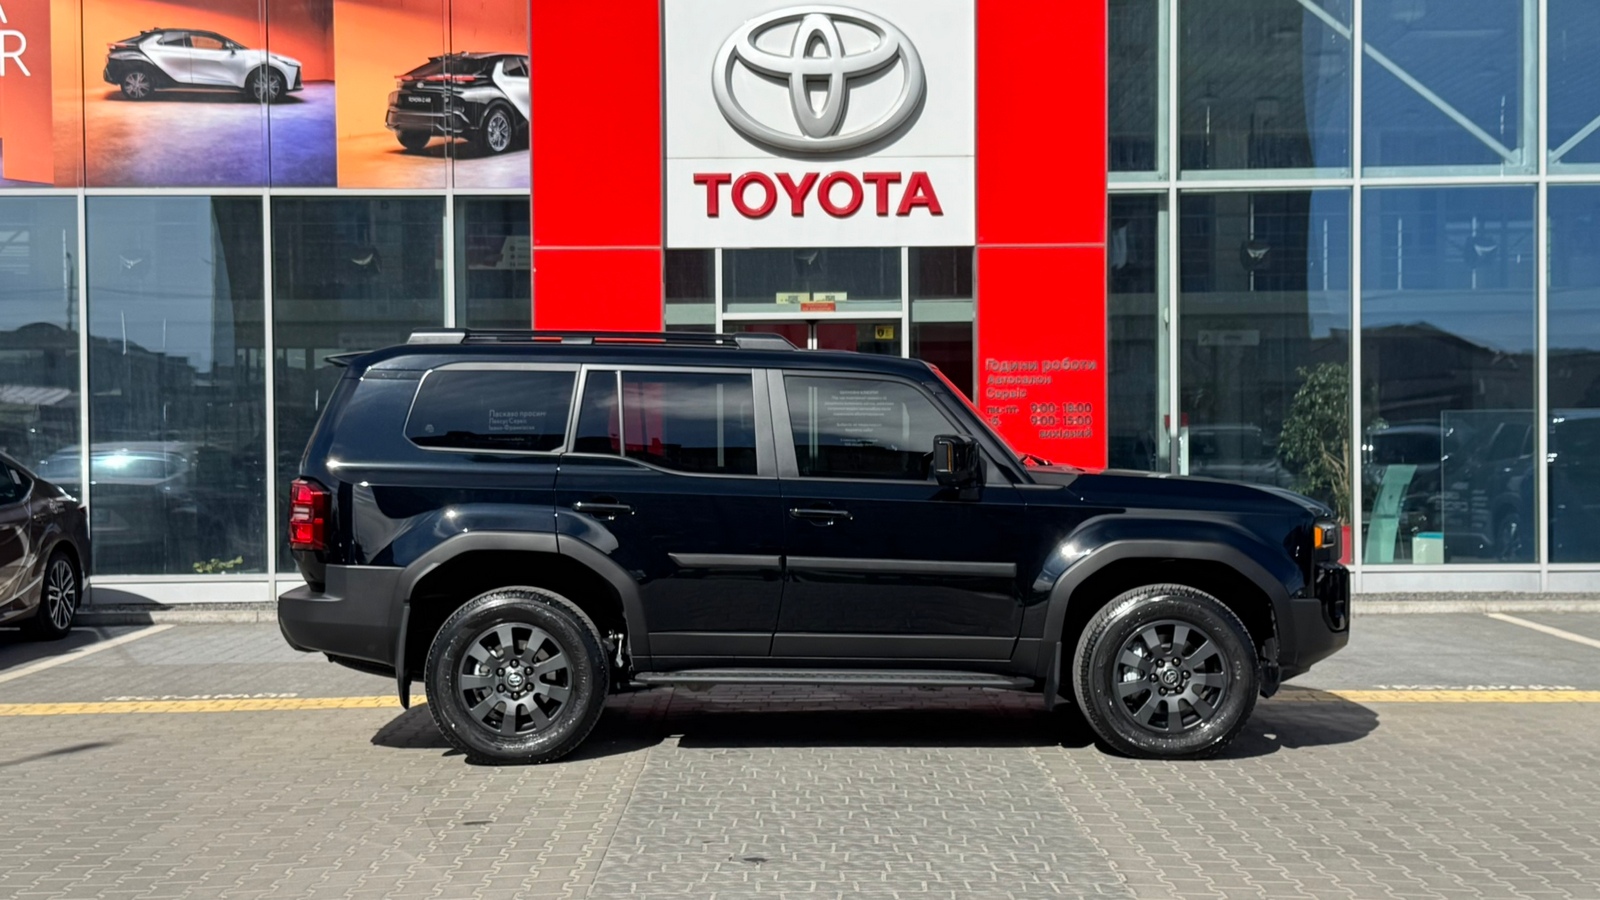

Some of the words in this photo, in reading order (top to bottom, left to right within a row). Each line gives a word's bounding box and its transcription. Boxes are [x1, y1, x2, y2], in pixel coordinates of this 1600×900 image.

[693, 170, 944, 219] TOYOTA
[986, 358, 1039, 373] Години
[1042, 357, 1097, 373] роботи
[987, 375, 1052, 385] Автосалон
[986, 388, 1027, 400] Сервіс
[1063, 402, 1092, 413] 18:00
